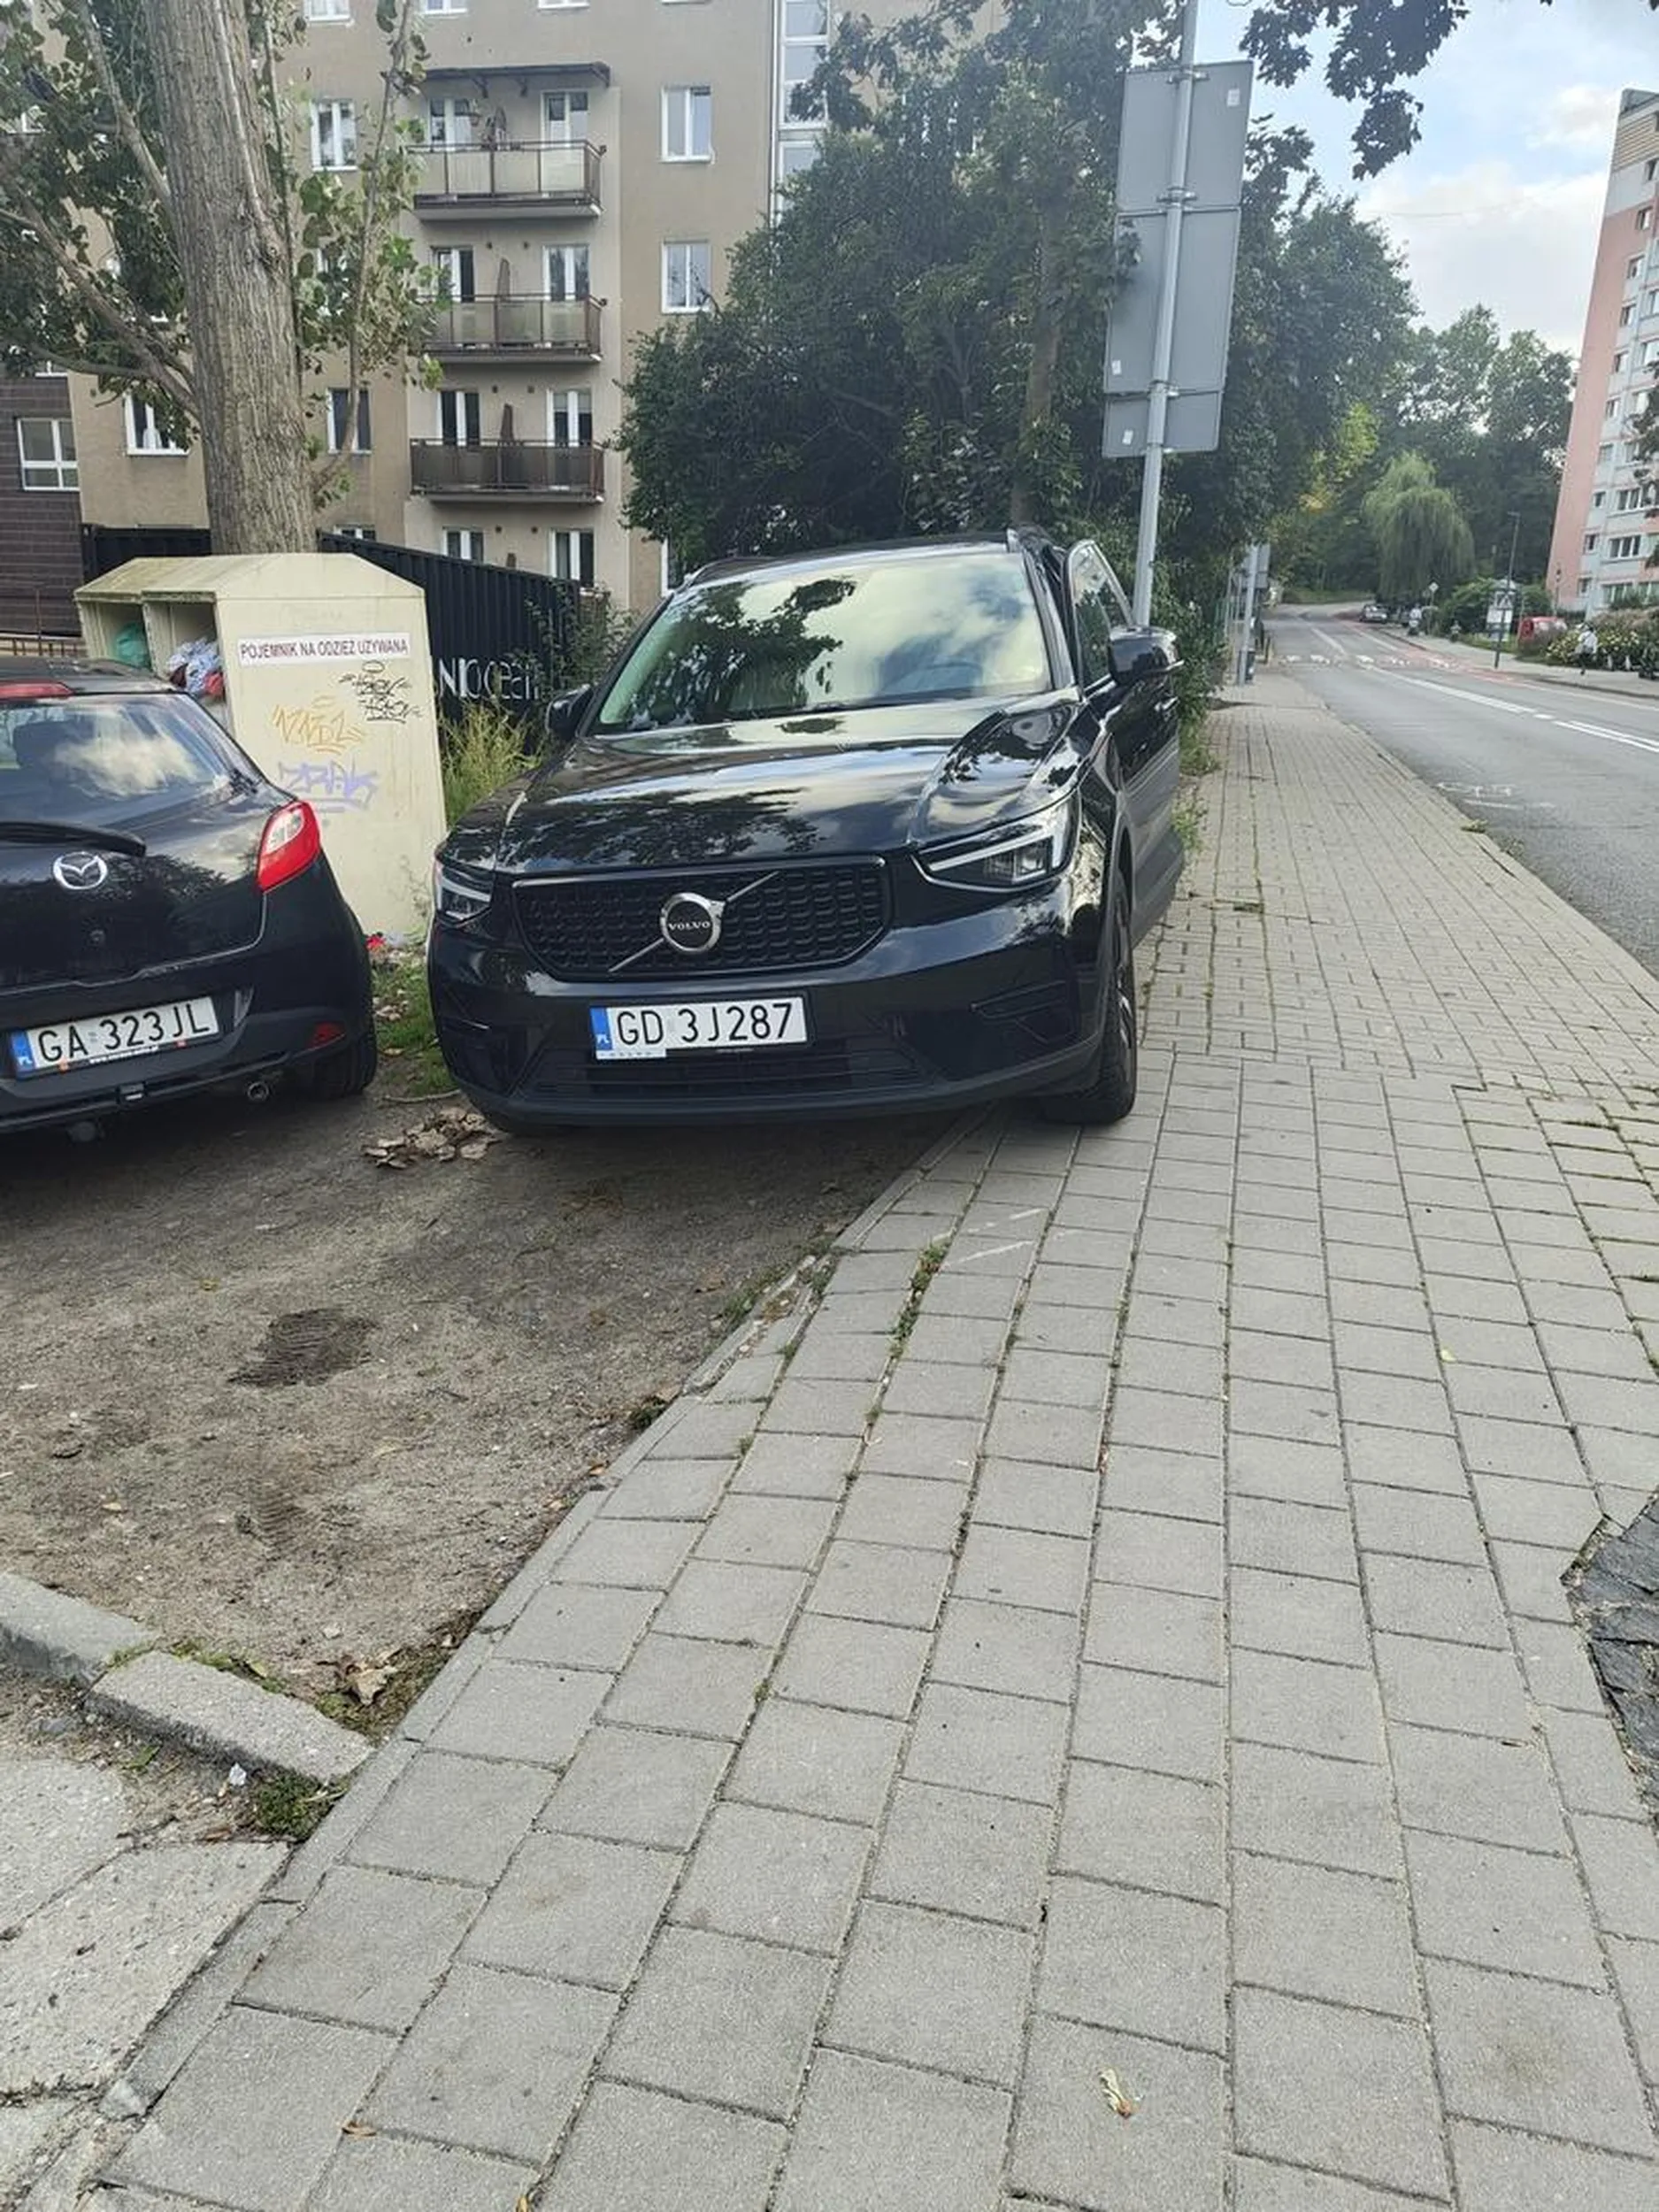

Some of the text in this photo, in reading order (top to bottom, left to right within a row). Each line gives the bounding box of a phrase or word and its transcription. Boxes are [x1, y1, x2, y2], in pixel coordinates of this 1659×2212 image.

[240, 641, 298, 659] POJEMNIK
[300, 641, 316, 657] NA
[667, 921, 710, 931] VOLVO
[37, 1025, 88, 1062] GA
[99, 1002, 210, 1051] 323JL
[617, 1002, 793, 1046] GD 3J287
